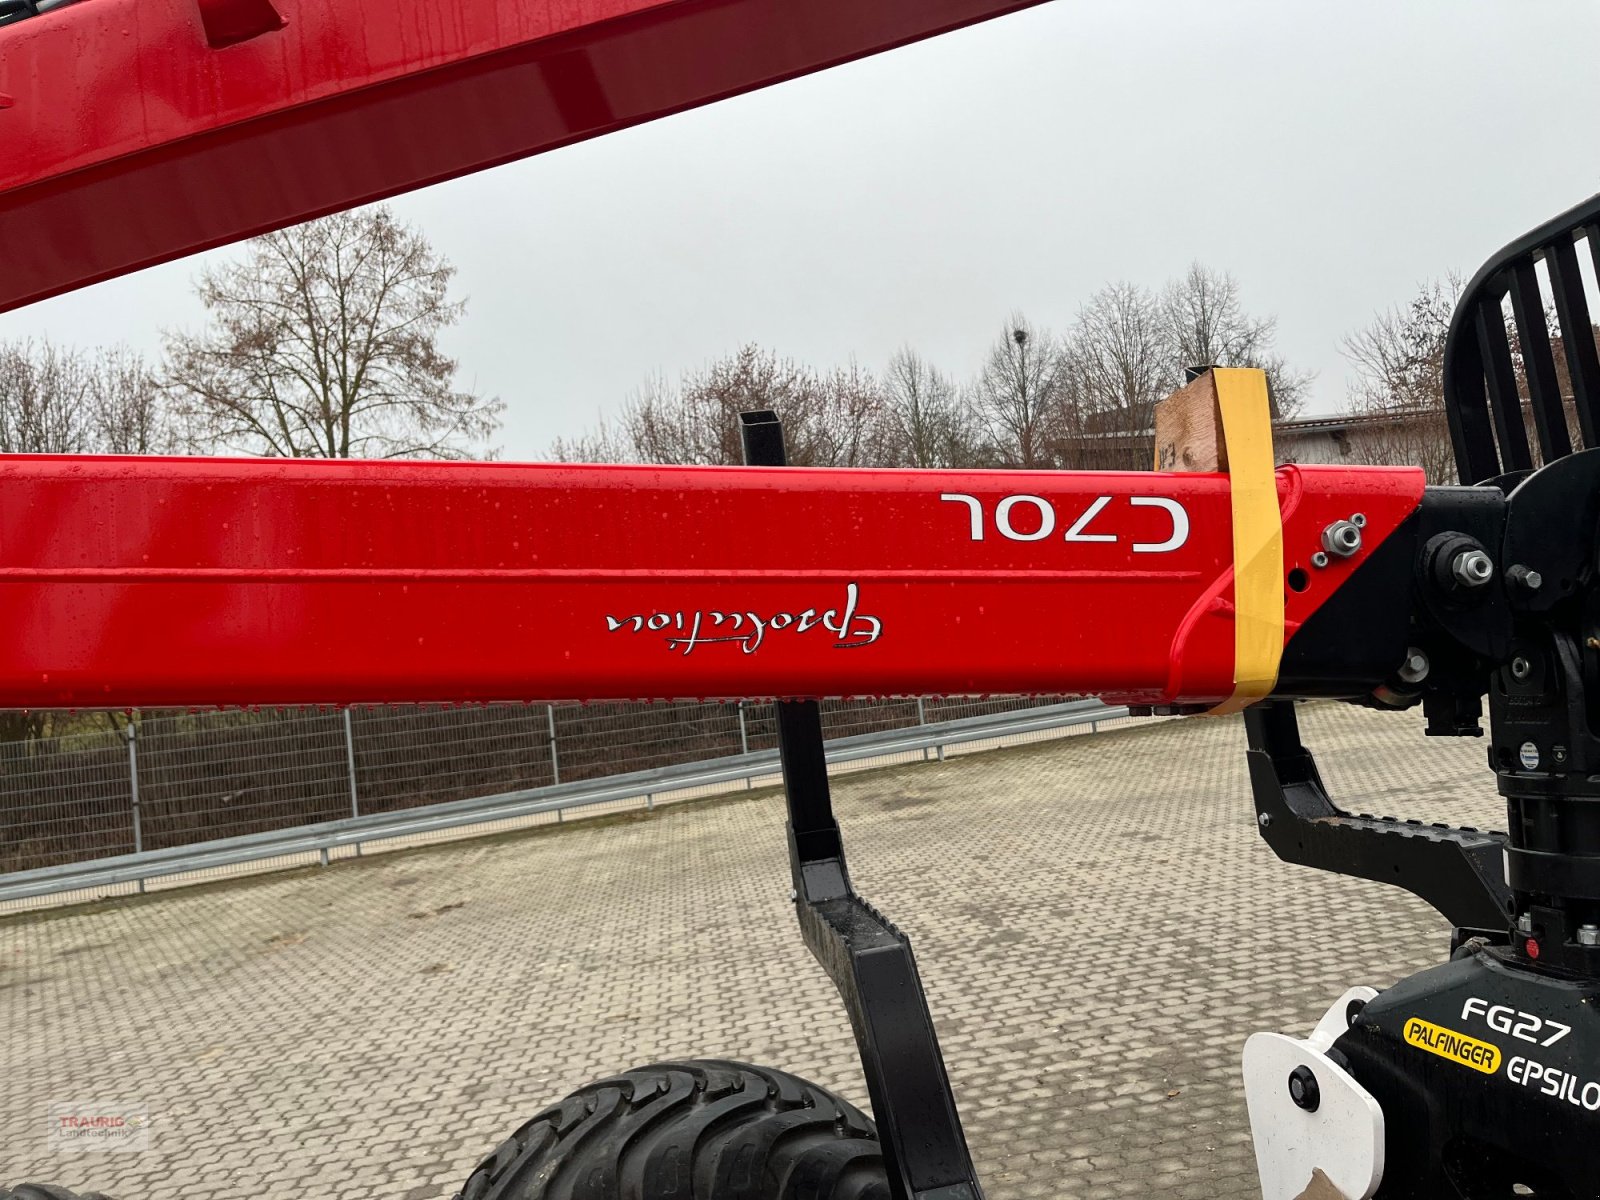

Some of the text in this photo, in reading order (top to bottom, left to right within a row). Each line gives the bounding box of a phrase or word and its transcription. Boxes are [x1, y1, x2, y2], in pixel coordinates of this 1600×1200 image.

[941, 493, 1191, 554] C70L
[606, 582, 883, 656] Epsolution
[1408, 1022, 1496, 1069] PALFINGER
[1461, 997, 1572, 1048] FG27
